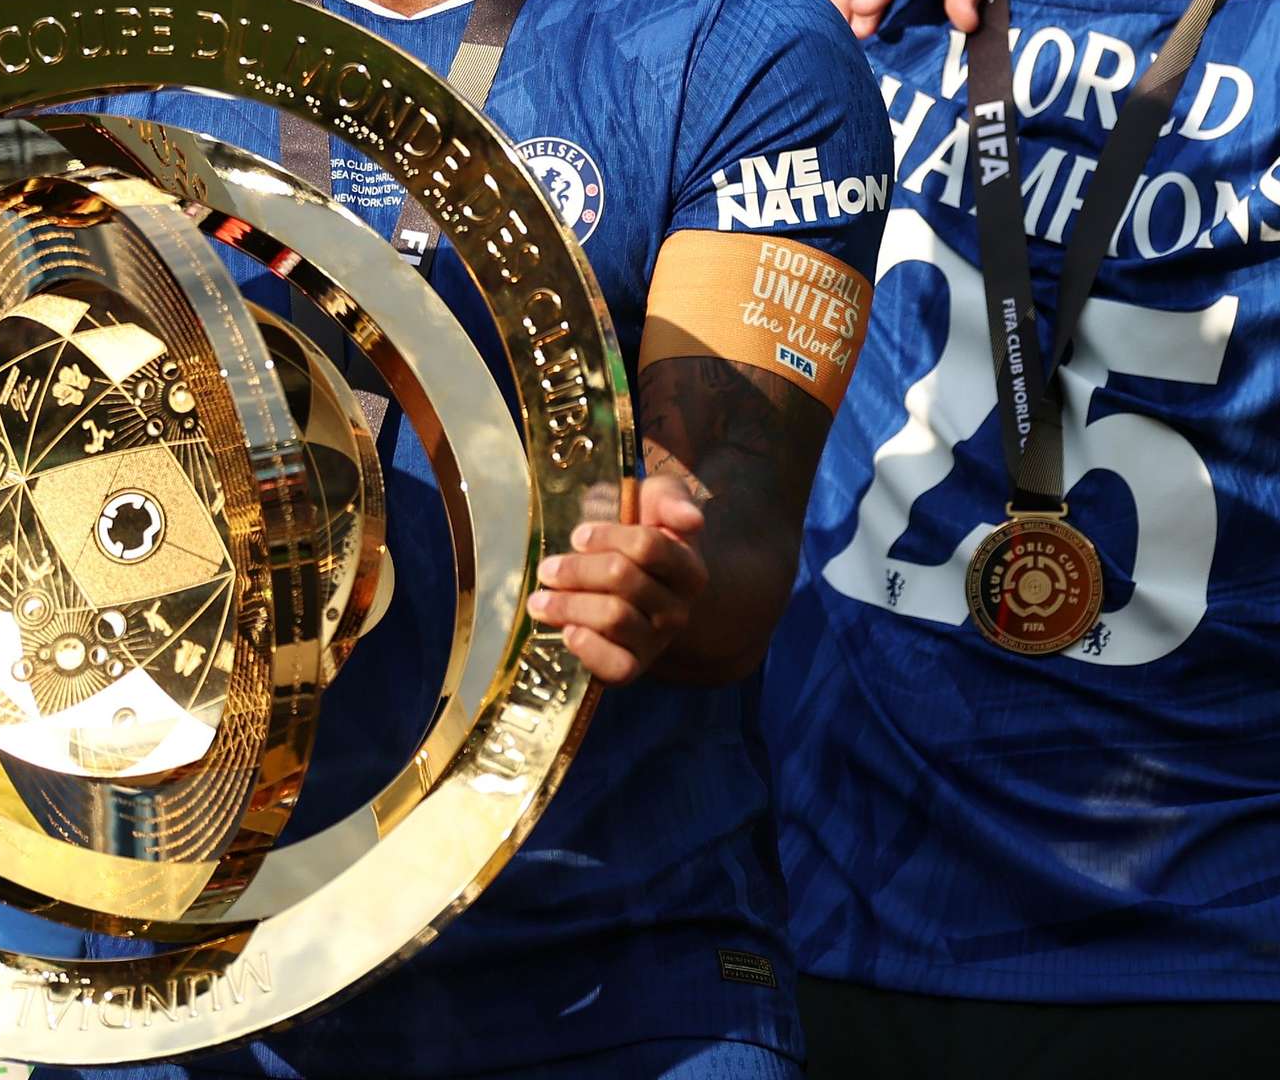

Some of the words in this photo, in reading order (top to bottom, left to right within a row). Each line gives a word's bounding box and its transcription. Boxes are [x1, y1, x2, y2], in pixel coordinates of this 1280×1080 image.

[941, 25, 1254, 141] ORD
[329, 159, 346, 168] IFA
[346, 160, 373, 171] CLUB
[974, 100, 1010, 187] FIFA
[333, 194, 357, 204] NEW
[351, 172, 365, 182] FC
[711, 147, 822, 197] LIVE
[717, 173, 889, 231] NATION
[399, 228, 430, 266] FI
[759, 241, 862, 309] FOOTBALL
[753, 266, 859, 339] UNITES
[1002, 297, 1017, 333] FIFA
[740, 301, 784, 334] the
[786, 315, 853, 374] World
[779, 347, 815, 377] FIFA
[1007, 334, 1023, 375] CLUB
[1012, 375, 1031, 444] WORLD
[990, 565, 1005, 604] CLUB
[1002, 542, 1056, 561] WORLD
[1059, 554, 1080, 580] CUP
[1022, 622, 1046, 633] FIFA
[12, 951, 273, 1031] MUNDIAL
